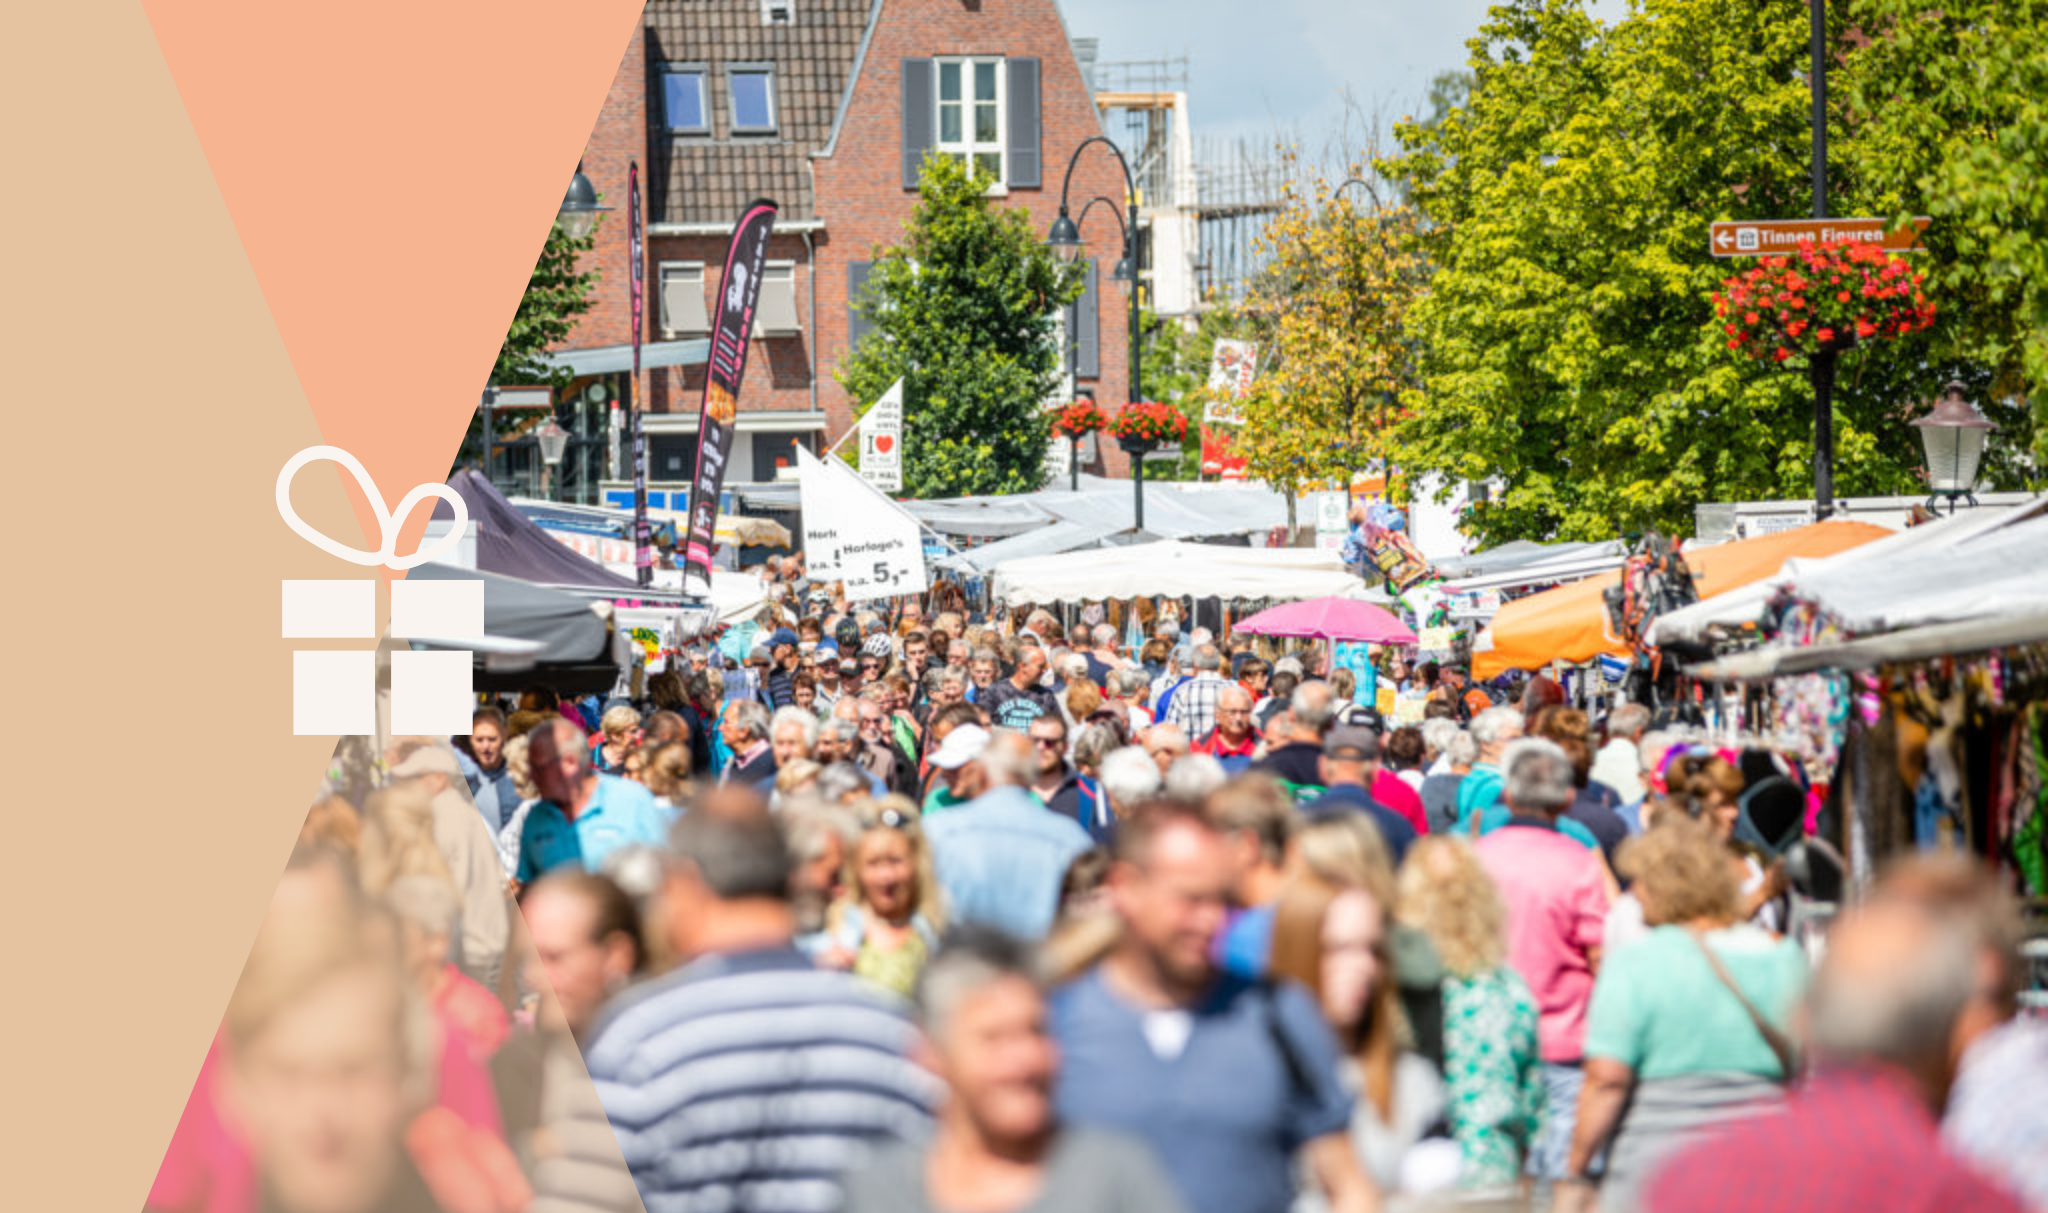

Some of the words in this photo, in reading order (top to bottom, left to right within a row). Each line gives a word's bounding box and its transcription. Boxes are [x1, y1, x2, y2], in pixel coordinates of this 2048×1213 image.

[1761, 229, 1815, 244] Tinnen
[867, 435, 874, 454] I
[873, 561, 909, 587] 5,-
